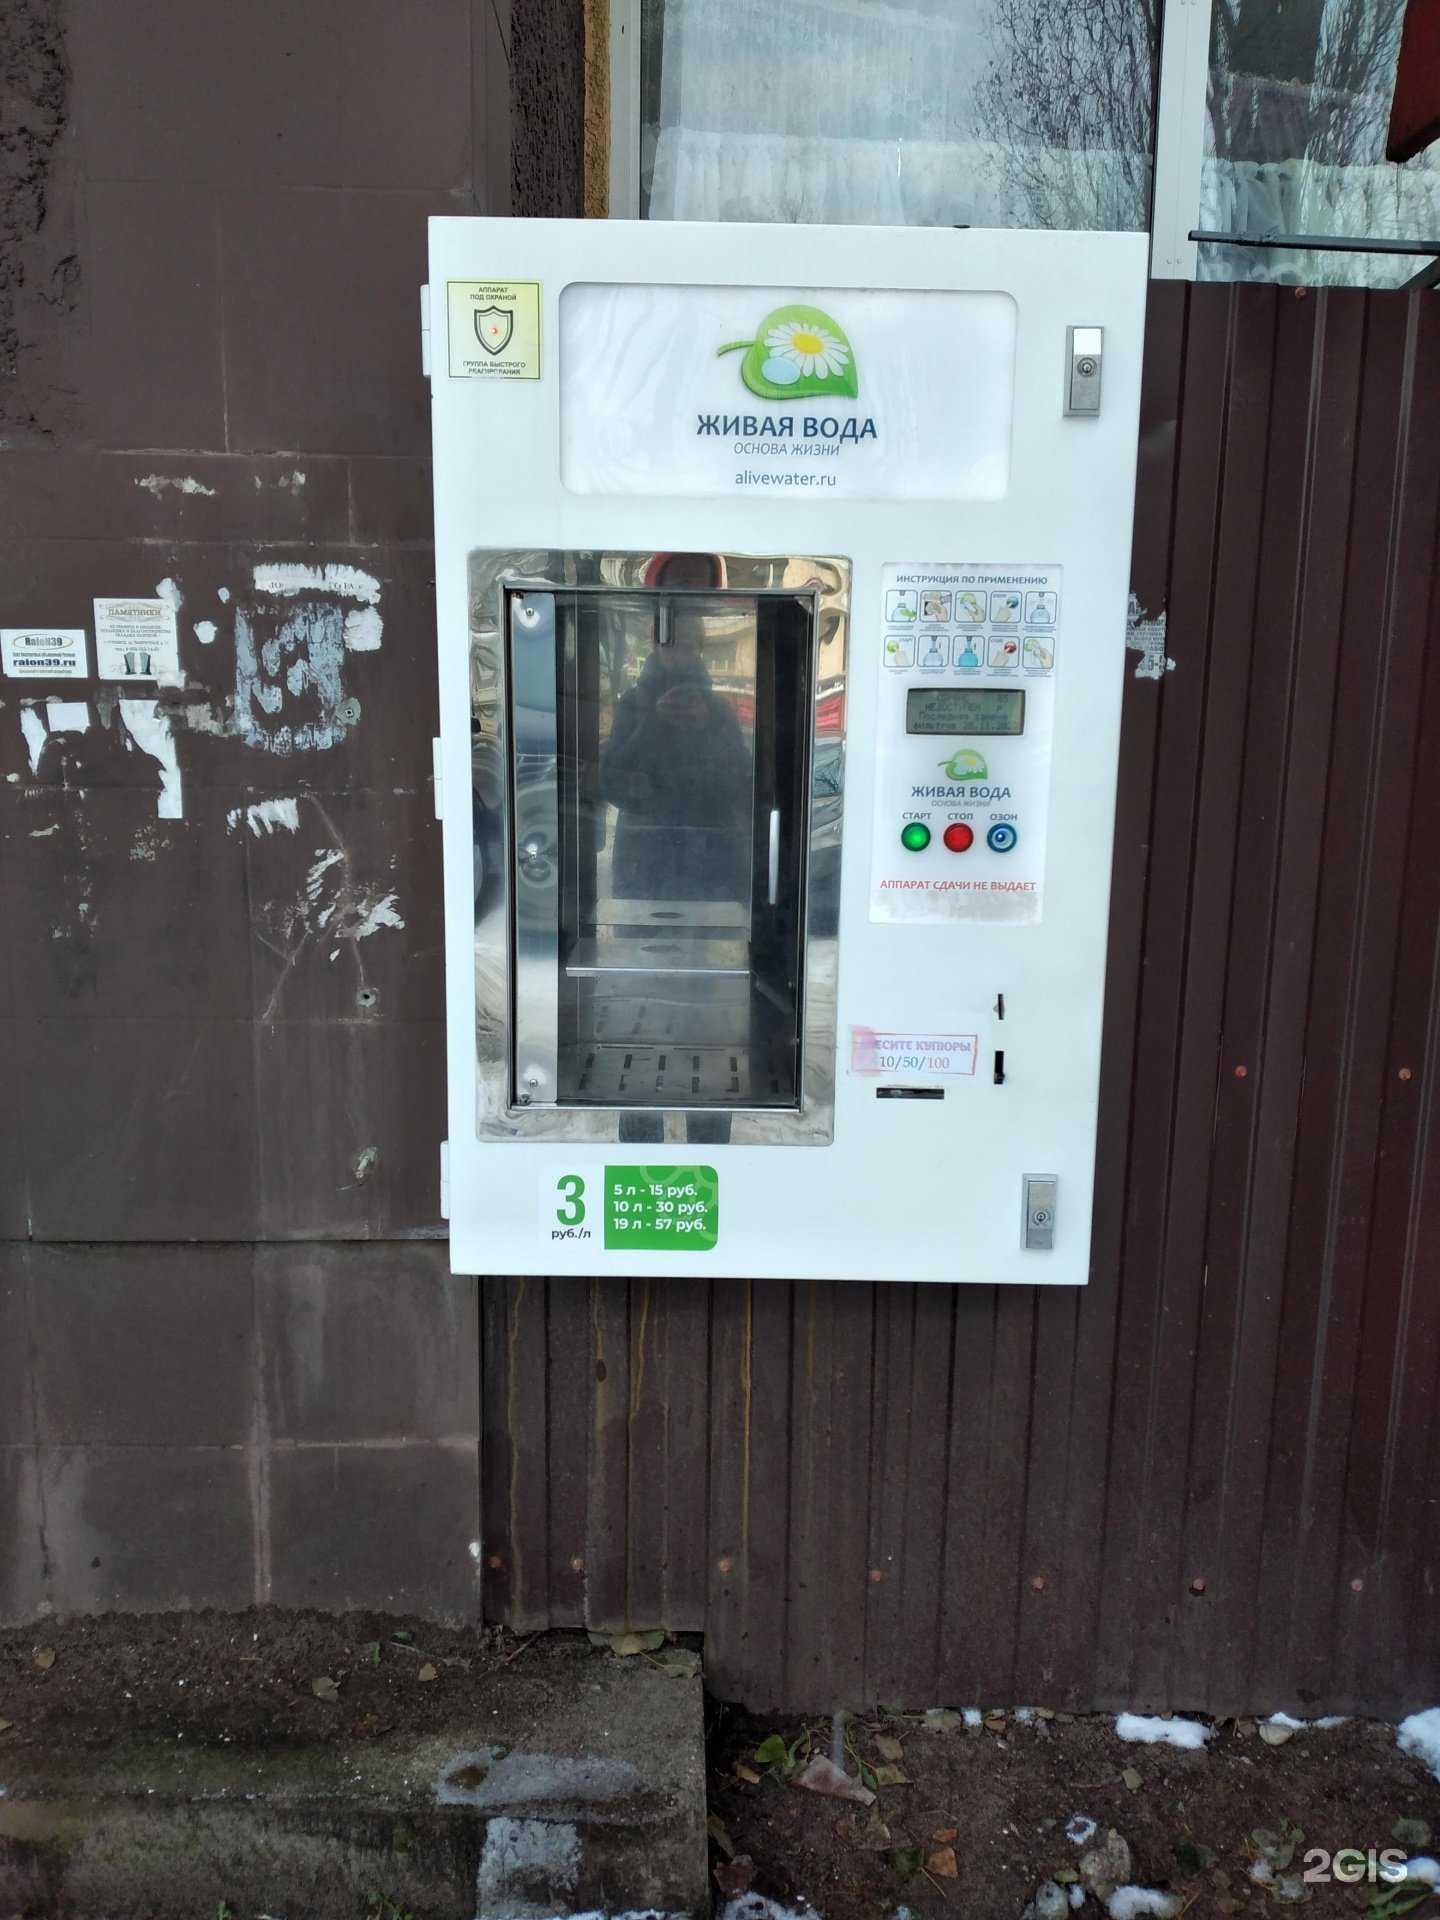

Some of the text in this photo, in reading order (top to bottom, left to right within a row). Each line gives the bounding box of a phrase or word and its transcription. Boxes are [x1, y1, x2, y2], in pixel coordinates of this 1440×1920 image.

[696, 414, 877, 444] ЖИВАЯ ВОДА
[734, 442, 840, 456] ОСНОВА ЖИЗНИ
[735, 470, 836, 486] alivewater.ru
[896, 575, 959, 584] ИНСТРУКЦИЯ
[978, 576, 1048, 584] ПРИМЕНЕНИЮ
[108, 607, 161, 616] ПАМЯТНИКИ
[13, 658, 76, 668] raion39.ru
[911, 786, 1011, 801] ЖИВАЯ ВОДА
[902, 812, 932, 820] СТАРТ
[990, 813, 1018, 821] ОЗОН
[880, 880, 1037, 892] АППАРАТ СДАЧИ НЕ ВЫДАЕТ
[880, 1055, 950, 1070] 10/50/100
[613, 1184, 623, 1195] 5
[626, 1187, 636, 1195] л
[649, 1184, 663, 1195] 15
[667, 1183, 698, 1198] руб.
[556, 1174, 586, 1226] 3
[613, 1201, 629, 1212] 10
[632, 1203, 642, 1212] л
[656, 1201, 674, 1213] 30
[678, 1201, 708, 1215] руб.
[613, 1218, 628, 1229] 19
[631, 1220, 641, 1229] л
[655, 1218, 672, 1230] 57
[676, 1218, 706, 1232] руб.
[551, 1228, 591, 1240] руб./л
